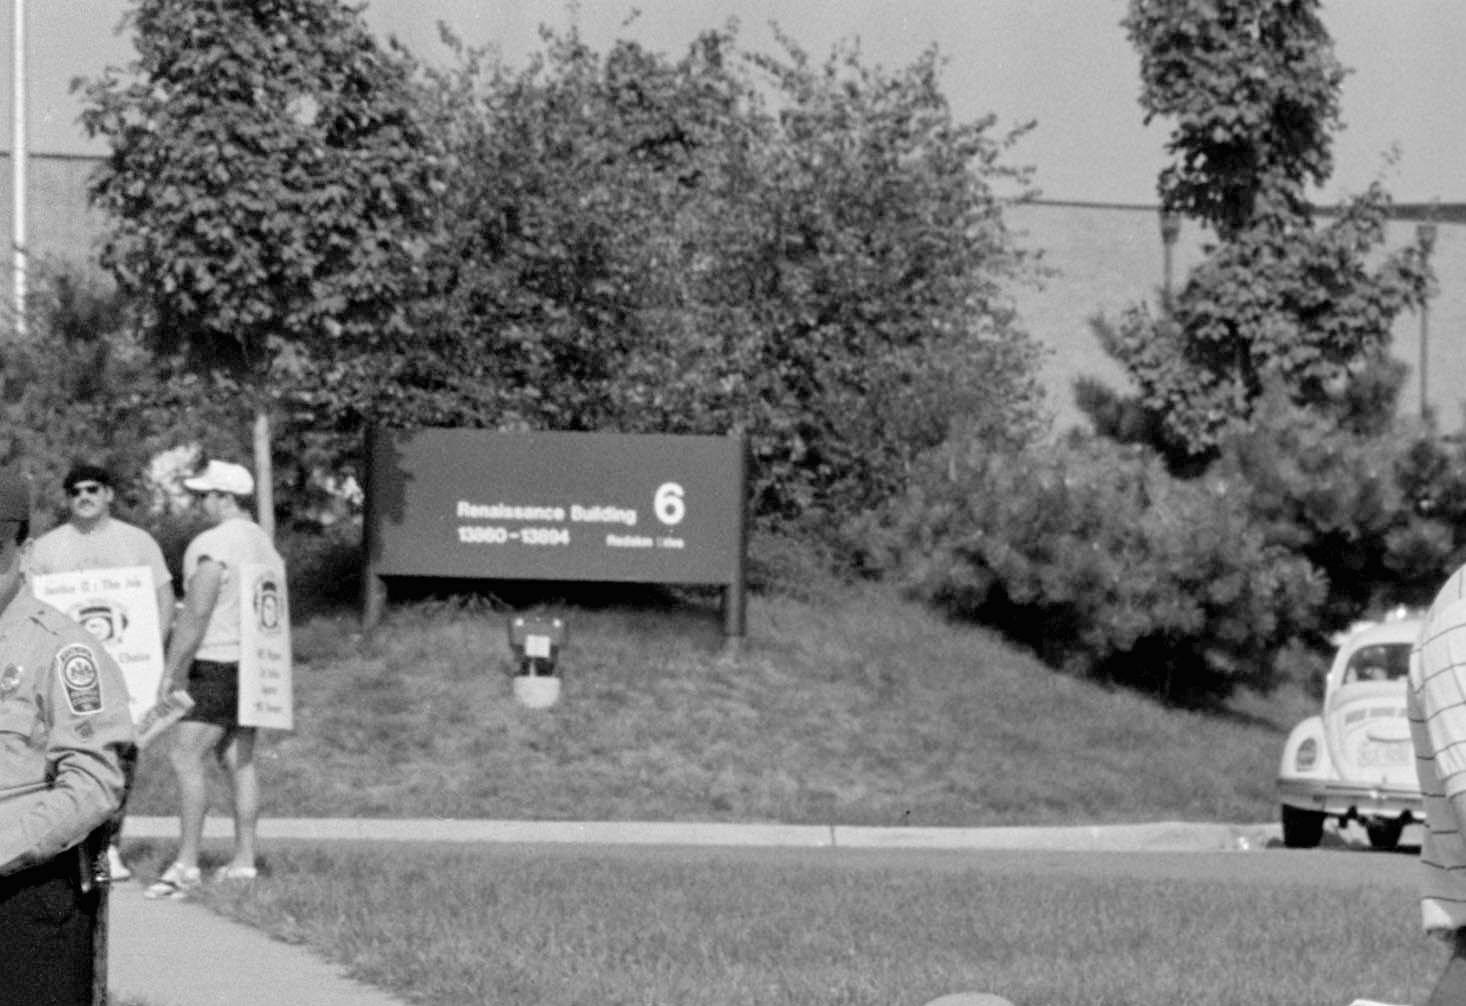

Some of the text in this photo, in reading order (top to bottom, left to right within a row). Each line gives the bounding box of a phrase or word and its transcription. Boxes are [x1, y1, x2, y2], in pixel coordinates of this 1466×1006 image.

[457, 482, 686, 526] Renaissance Building 6
